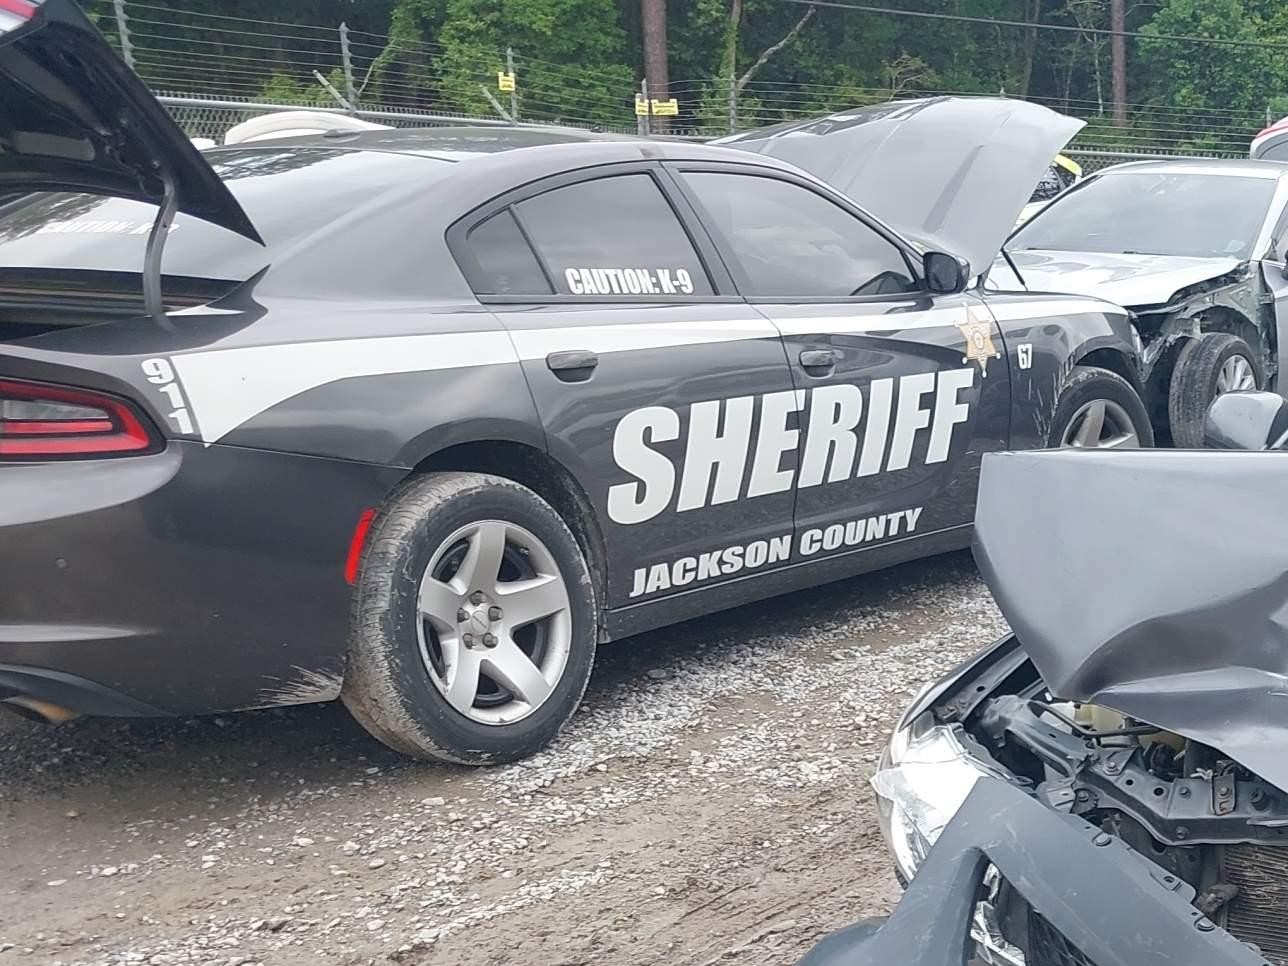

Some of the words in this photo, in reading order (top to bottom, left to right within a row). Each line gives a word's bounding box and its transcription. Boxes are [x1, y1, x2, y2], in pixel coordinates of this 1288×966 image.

[565, 267, 660, 295] CAUTION:
[656, 268, 694, 294] K-9
[1017, 343, 1033, 370] 67
[141, 358, 194, 435] 911
[607, 367, 975, 526] SHERIFF
[629, 534, 795, 598] JACKSON
[799, 506, 925, 557] COUNTY
